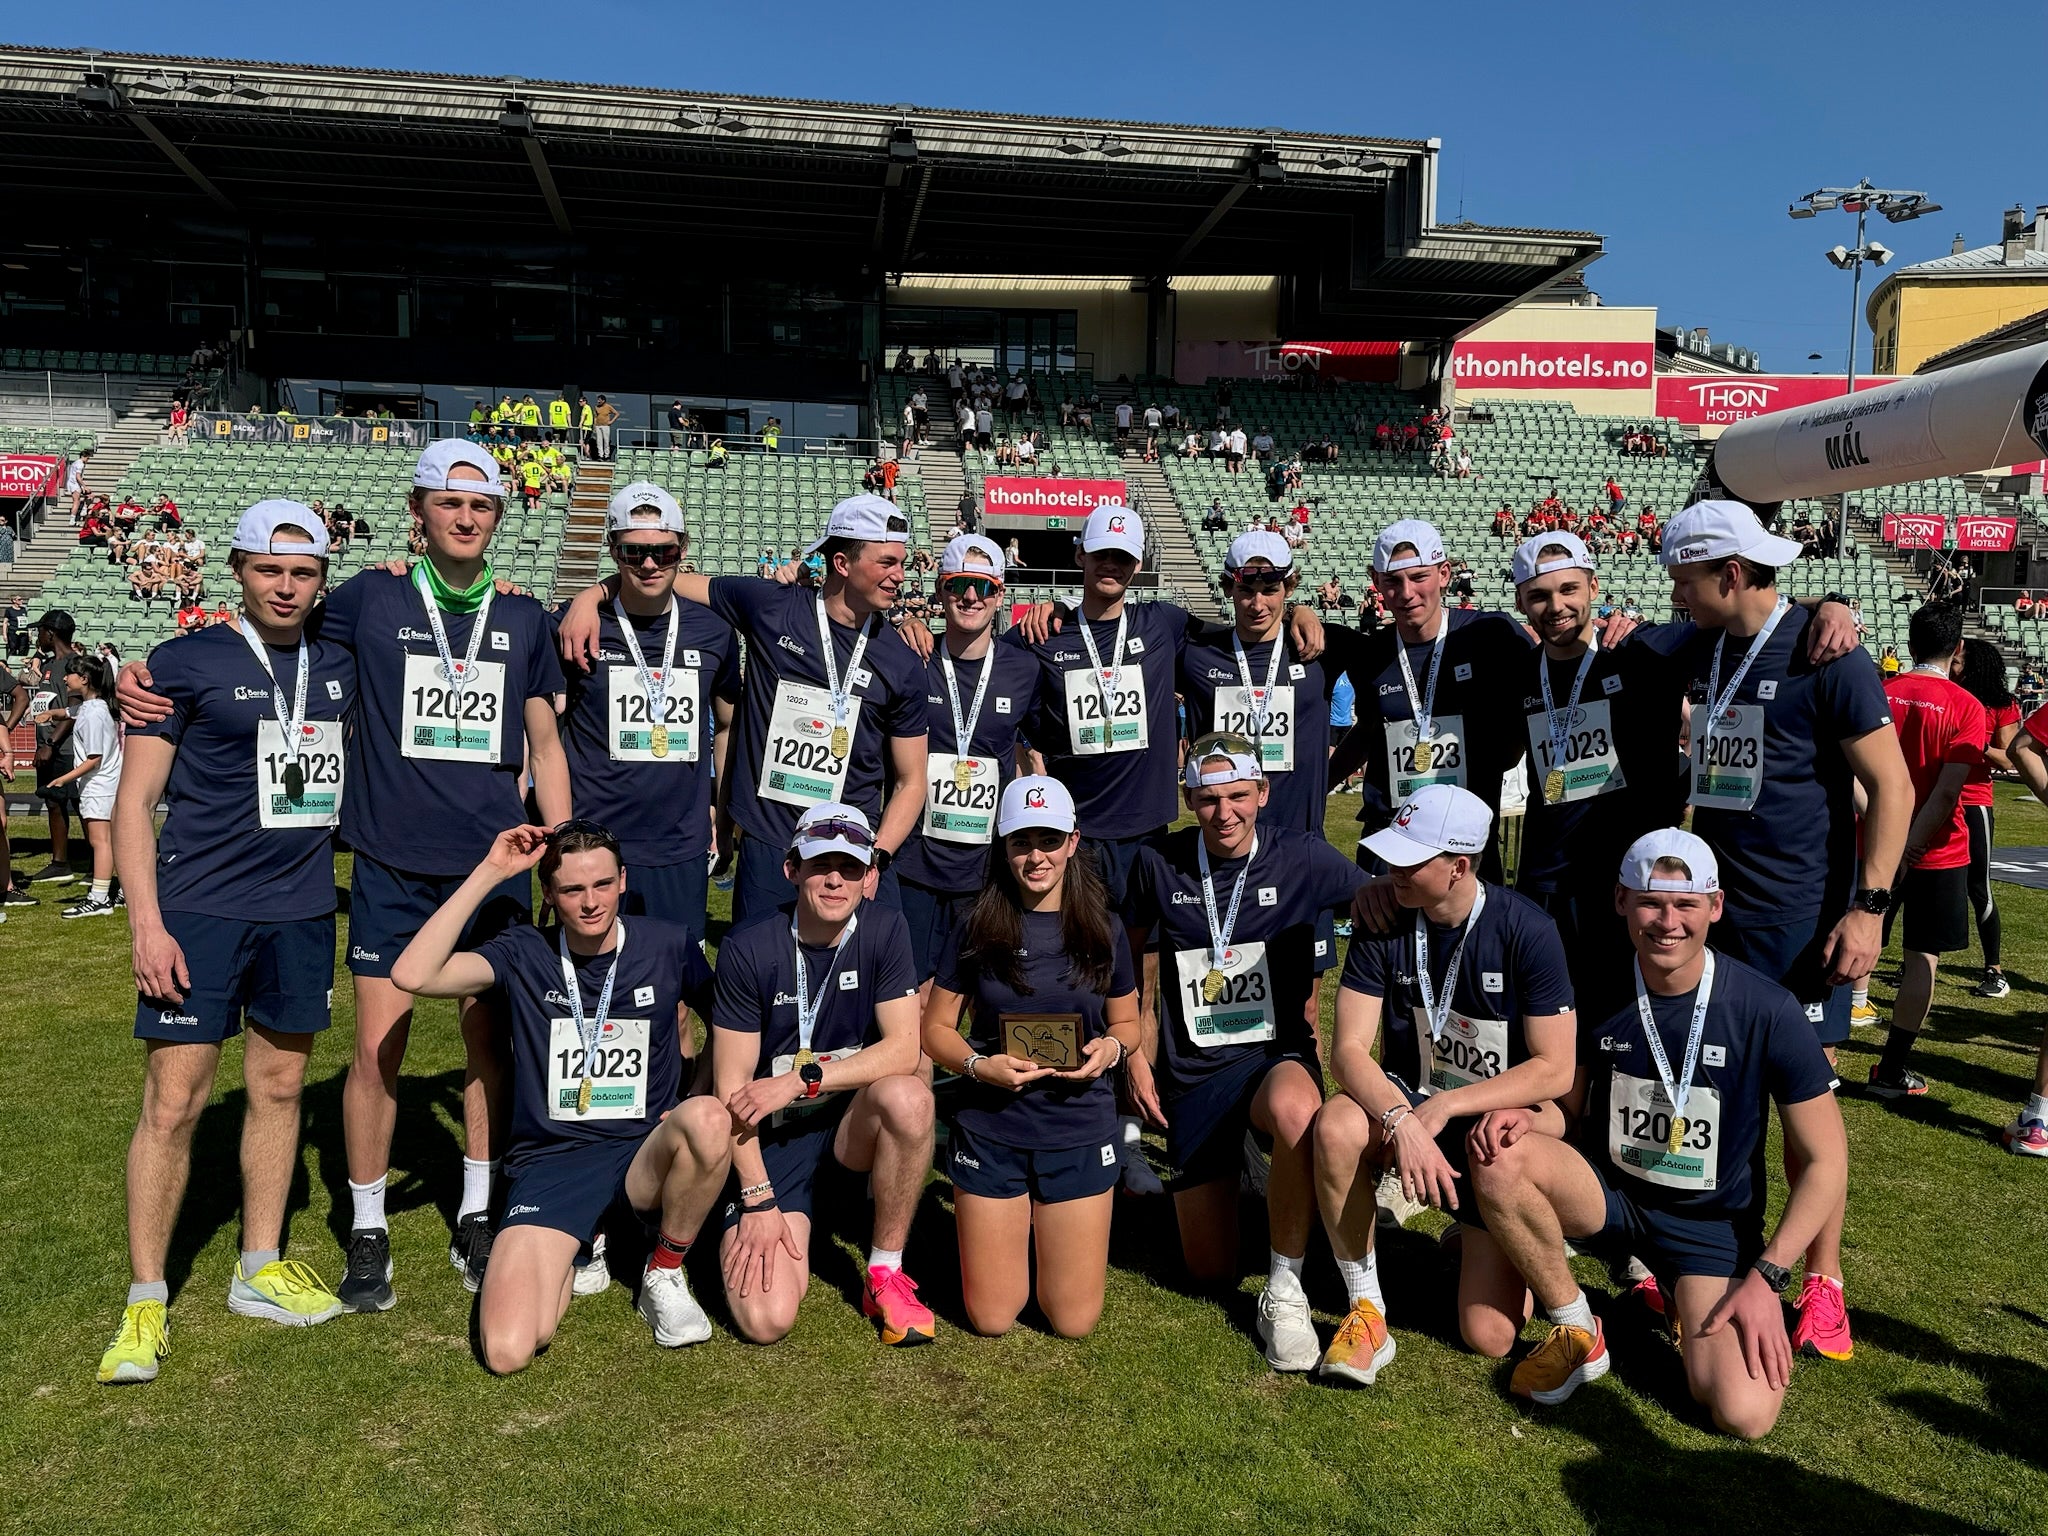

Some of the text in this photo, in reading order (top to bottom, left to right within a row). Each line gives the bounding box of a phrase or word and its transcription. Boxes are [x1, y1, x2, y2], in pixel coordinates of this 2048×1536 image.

[1454, 353, 1648, 378] thonhotels.no
[1688, 381, 1779, 407] THON
[1706, 410, 1758, 421] HOTELS
[233, 424, 255, 433] BACKE
[312, 428, 334, 436] BACKE
[389, 431, 412, 439] BACKE
[1825, 421, 1870, 470] MÅL
[0, 460, 51, 482] HON
[1, 482, 45, 492] HOTELS
[989, 487, 1122, 507] thonhotels.no
[1888, 518, 1942, 536] THON
[1961, 520, 2014, 539] THON
[1898, 536, 1930, 545] HOTELS
[1970, 539, 2001, 548] HOTELS
[33, 701, 47, 712] 3033
[412, 686, 497, 722] 12023
[786, 695, 850, 715] 12023 123
[416, 727, 434, 738] JOB
[622, 733, 637, 742] JOB
[1112, 727, 1138, 736] &talent
[415, 738, 435, 746] ZONE
[773, 736, 843, 776] 12023
[1392, 742, 1461, 773] 1223
[1697, 735, 1758, 769] 12023
[1570, 769, 1610, 784] job&talent
[792, 780, 832, 796] job&talent
[932, 778, 996, 810] 12023
[273, 794, 289, 807] JOB
[301, 799, 335, 808] ob&talent
[954, 819, 987, 830] job&talent
[360, 949, 380, 959] Bardo
[175, 1014, 198, 1023] Bardo
[1197, 1017, 1212, 1029] JOB
[1682, 1014, 1700, 1079] HOLMENKOLLSTAFETTEN
[557, 1048, 642, 1079] 12023
[562, 1090, 577, 1101] JOB
[591, 1092, 633, 1101] ob&talent
[1624, 1147, 1640, 1159] JOB
[1652, 1158, 1702, 1172] job&talent
